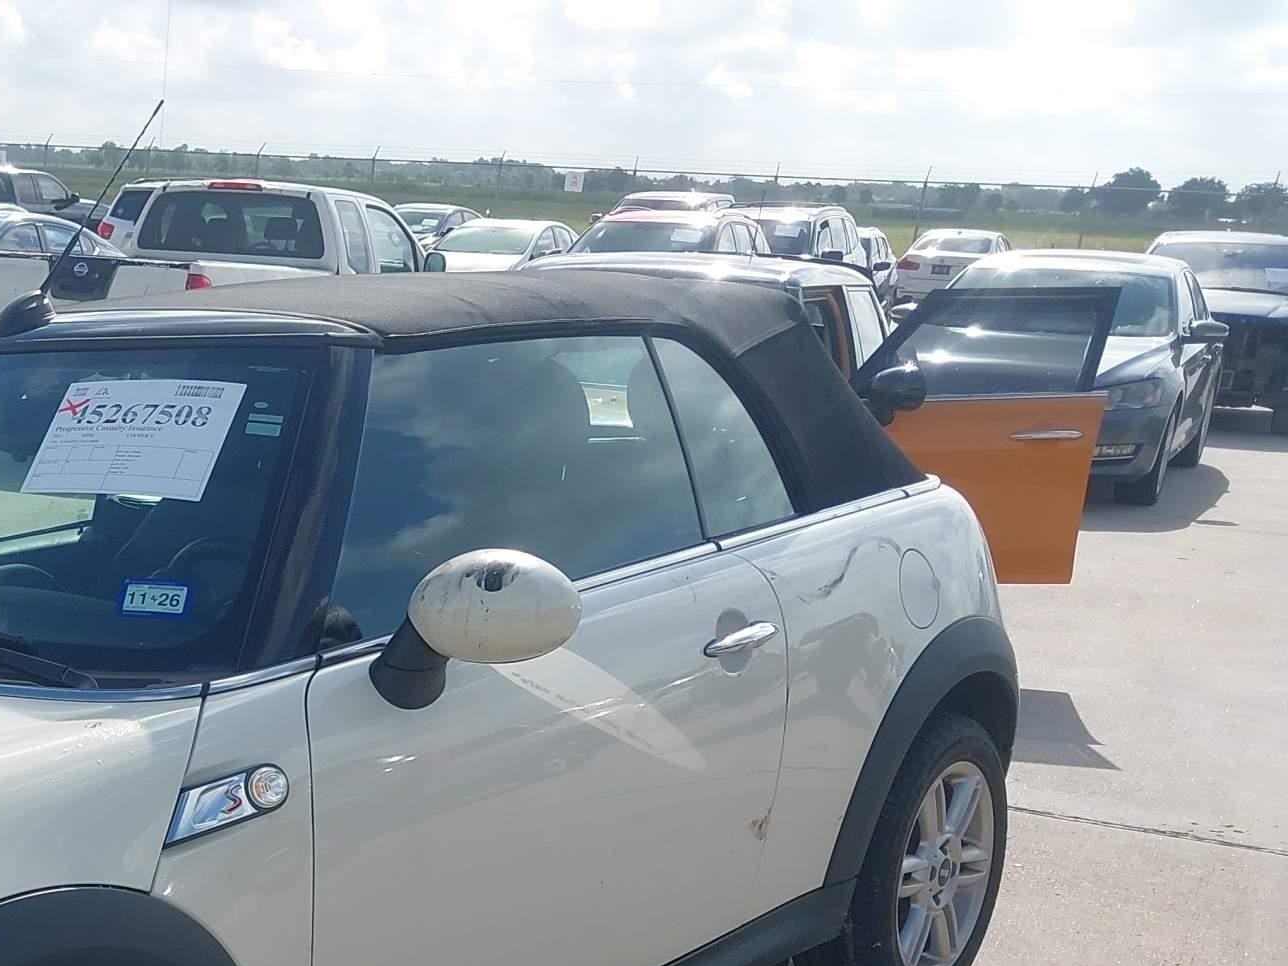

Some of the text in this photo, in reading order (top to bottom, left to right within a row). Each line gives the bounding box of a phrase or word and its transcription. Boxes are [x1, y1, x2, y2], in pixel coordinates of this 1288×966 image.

[71, 403, 212, 427] 45267508
[55, 425, 95, 433] Progressive
[96, 424, 125, 433] Casualty
